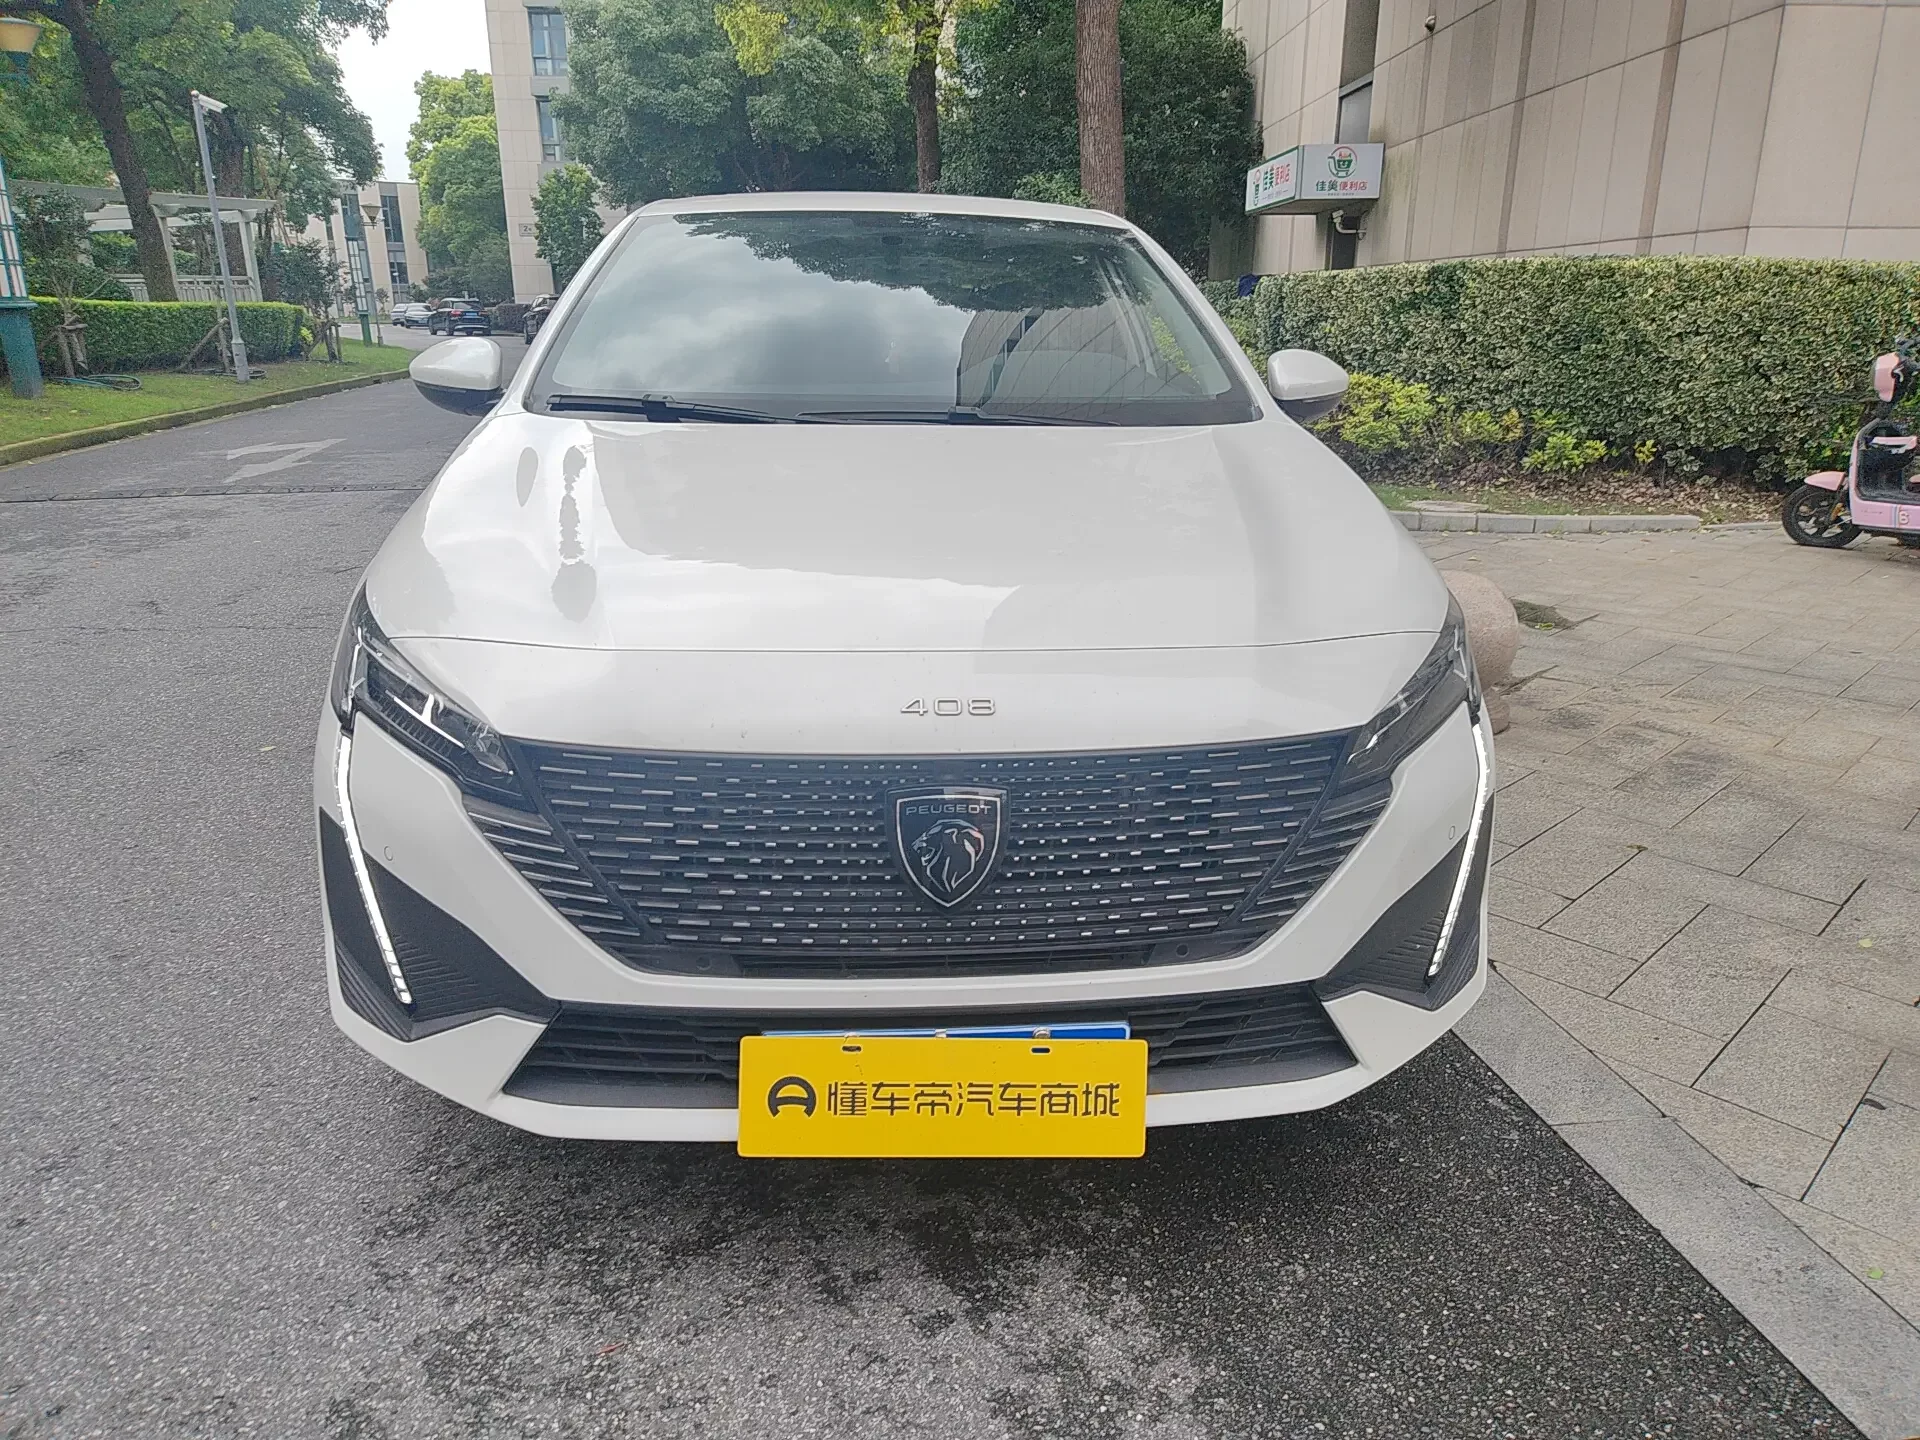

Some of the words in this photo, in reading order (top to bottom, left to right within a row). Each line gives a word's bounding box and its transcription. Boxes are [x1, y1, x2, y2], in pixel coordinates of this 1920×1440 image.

[900, 698, 996, 716] 408
[905, 804, 992, 816] PEUGEOT
[826, 1081, 1121, 1118] 懂车帝汽车商城
